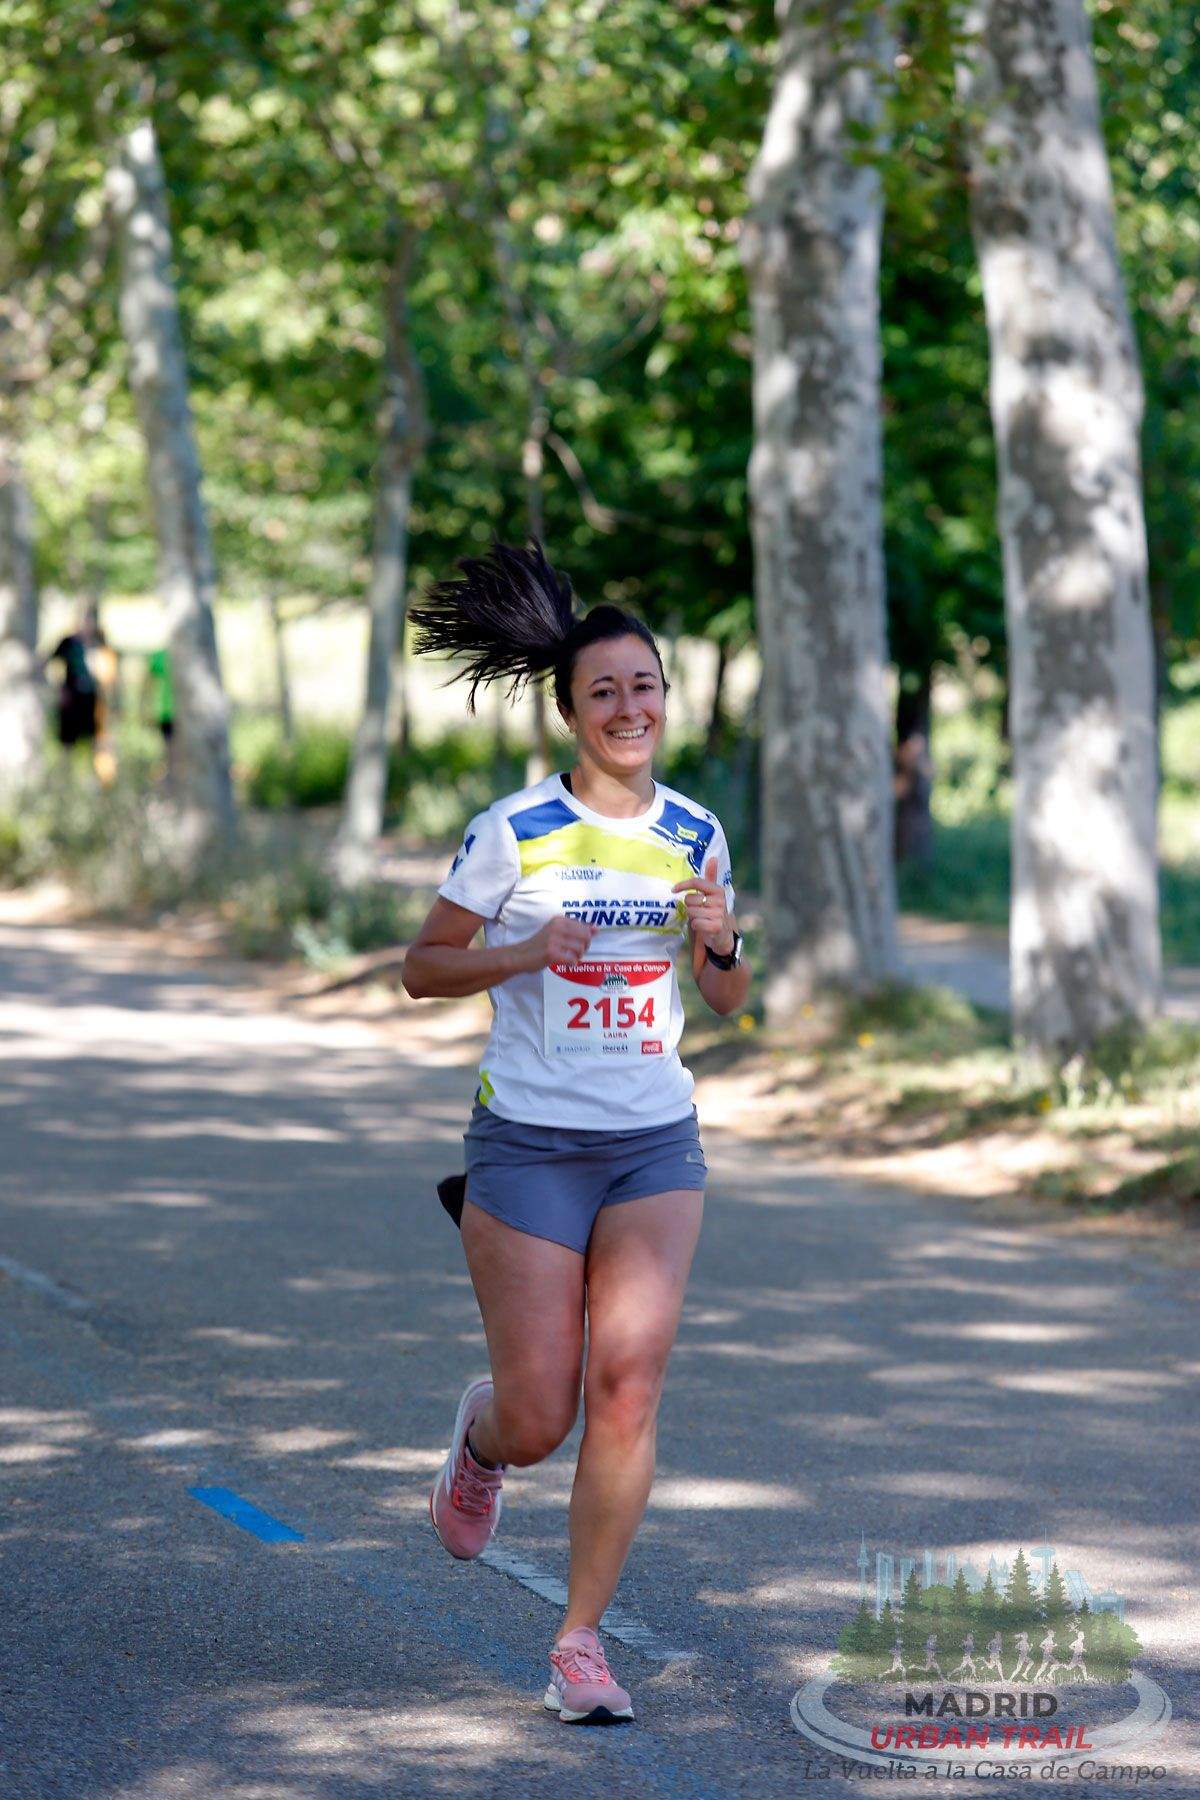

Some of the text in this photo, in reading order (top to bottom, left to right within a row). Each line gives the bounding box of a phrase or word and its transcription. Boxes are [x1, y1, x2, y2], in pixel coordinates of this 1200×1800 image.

[562, 899, 676, 908] MARAZUELA
[568, 963, 595, 973] Vuelta
[596, 965, 602, 973] a
[603, 962, 611, 973] la
[614, 963, 632, 973] Casa
[633, 962, 642, 972] de
[643, 963, 667, 974] Campo
[567, 997, 655, 1029] 2154
[603, 1031, 628, 1039] LAURA
